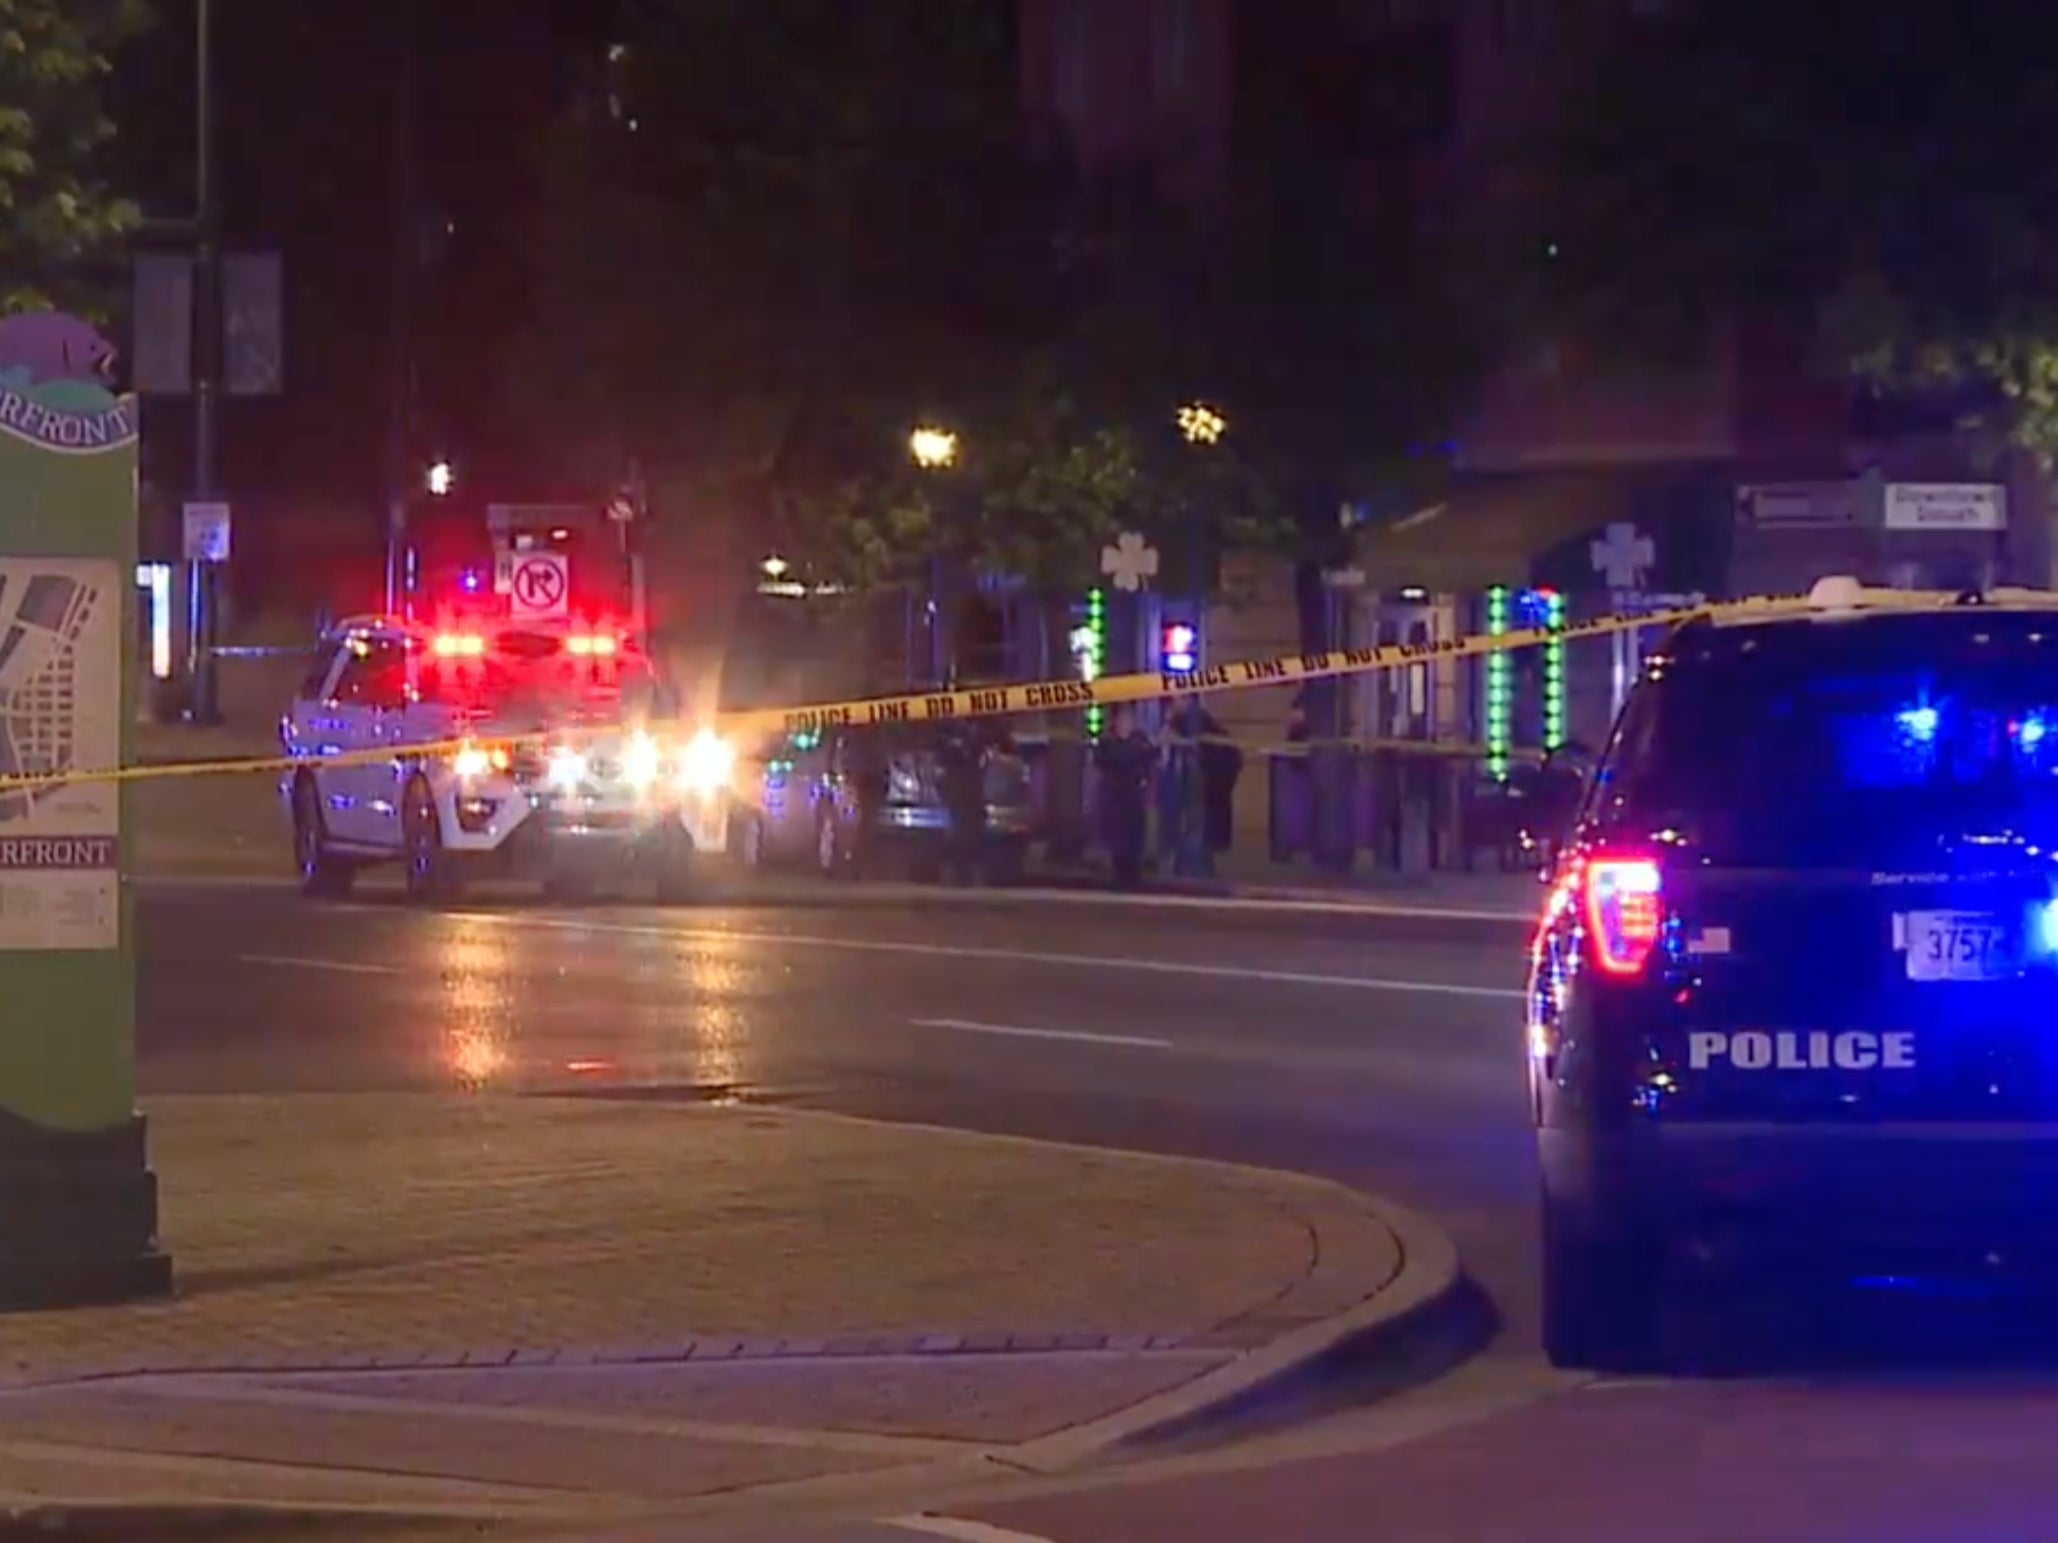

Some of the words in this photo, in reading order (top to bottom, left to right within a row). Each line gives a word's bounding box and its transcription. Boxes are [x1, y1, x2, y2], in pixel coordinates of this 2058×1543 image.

[1162, 665, 1230, 691] POLICE
[1244, 656, 1287, 680] LINE
[1302, 654, 1331, 672] DO
[784, 706, 853, 730] POLICE
[868, 699, 910, 723] LINE
[926, 694, 956, 718] DO
[968, 688, 1008, 711] NOT
[1025, 679, 1095, 706] CROSS
[0, 838, 111, 866] RFRONT
[1688, 1030, 1917, 1070] POLICE
